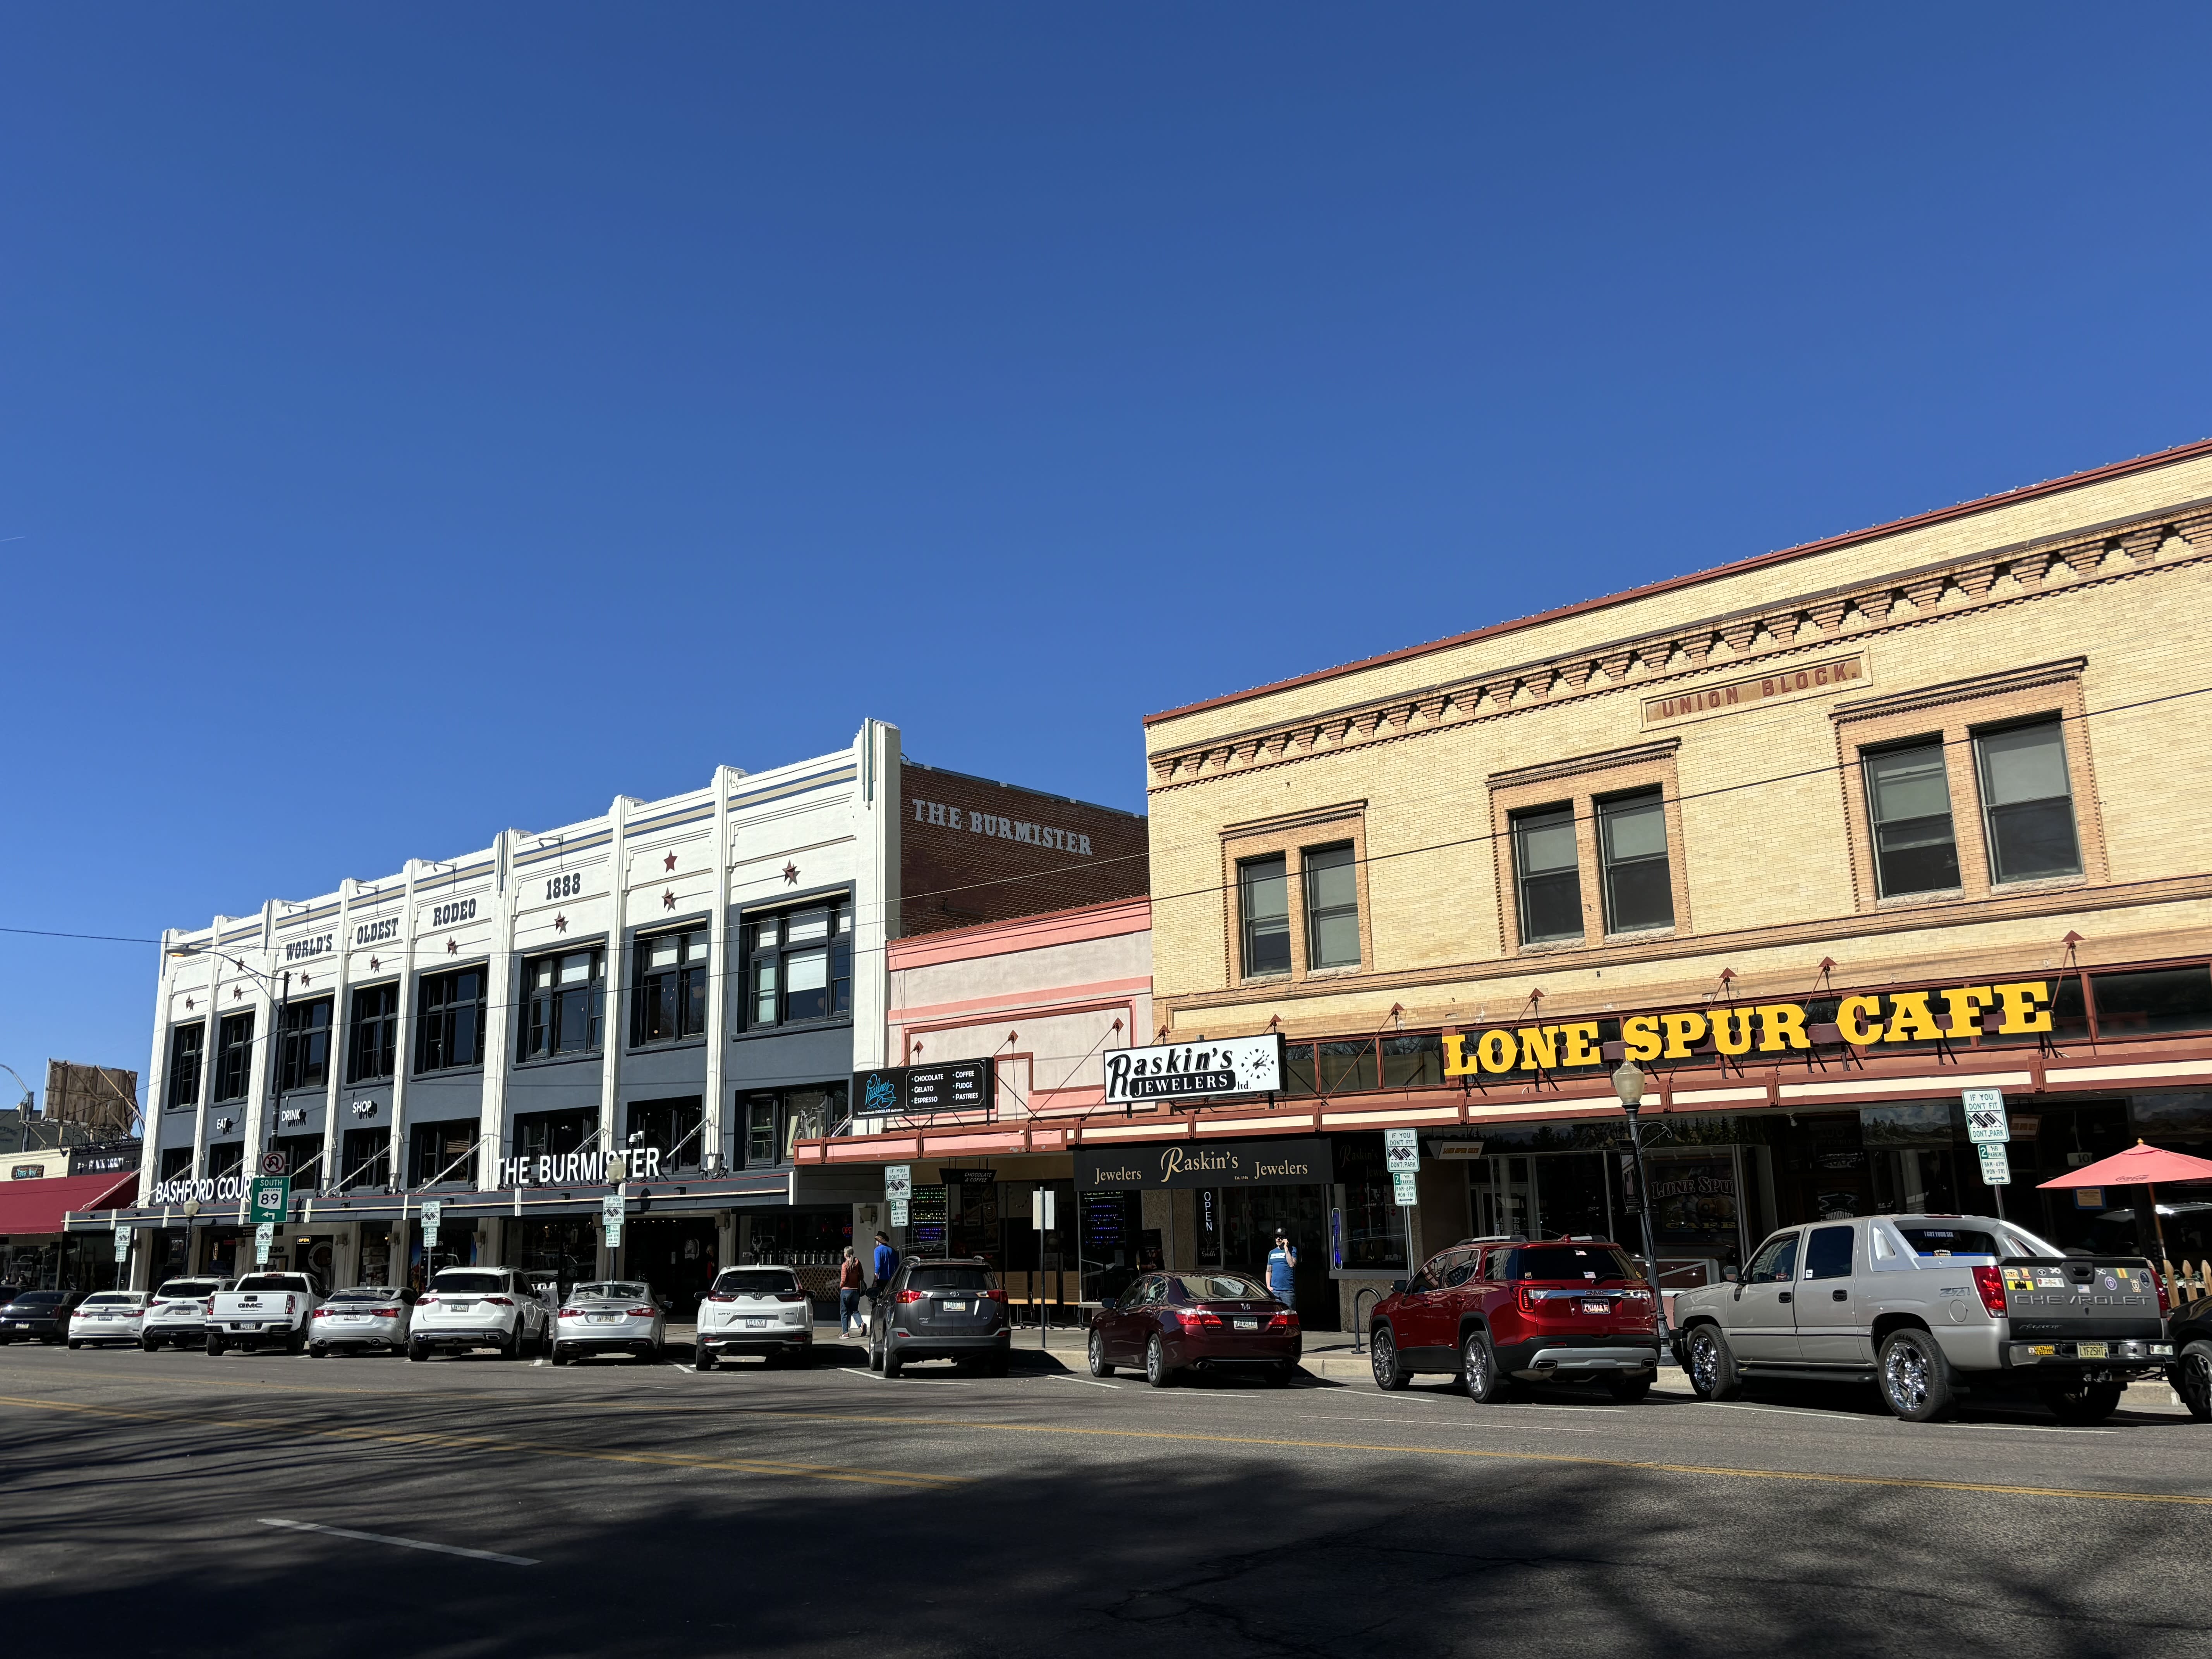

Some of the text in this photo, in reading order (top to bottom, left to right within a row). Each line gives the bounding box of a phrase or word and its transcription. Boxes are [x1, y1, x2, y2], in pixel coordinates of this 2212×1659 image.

[1662, 687, 1738, 717] UNION
[912, 799, 1092, 855] THE BURMISTER
[286, 872, 580, 961] WORLD'S OLDEST RODEO 1888
[1441, 981, 2053, 1076] LONE SPUR CAFE
[914, 1074, 944, 1082] CHOCOLATE
[1107, 1048, 1233, 1098] Raskin's
[1134, 1074, 1252, 1097] JEWELERS ltd.
[282, 1109, 301, 1121] DRINK
[352, 1100, 372, 1113] SHOP
[217, 1118, 227, 1129] EAT
[1980, 1147, 1987, 1157] 2
[494, 1156, 530, 1184] THE
[1095, 1167, 1141, 1184] Jewelers
[1254, 1159, 1308, 1180] Jewelers
[1161, 1147, 1238, 1182] Raskin's
[156, 1175, 266, 1202] BASHFORD COUR
[1395, 1175, 1399, 1183] 2
[1651, 1179, 1696, 1199] LONE
[261, 1194, 279, 1205] 89
[1204, 1192, 1212, 1231] OPEN
[2015, 1295, 2151, 1305] CHEVROLET
